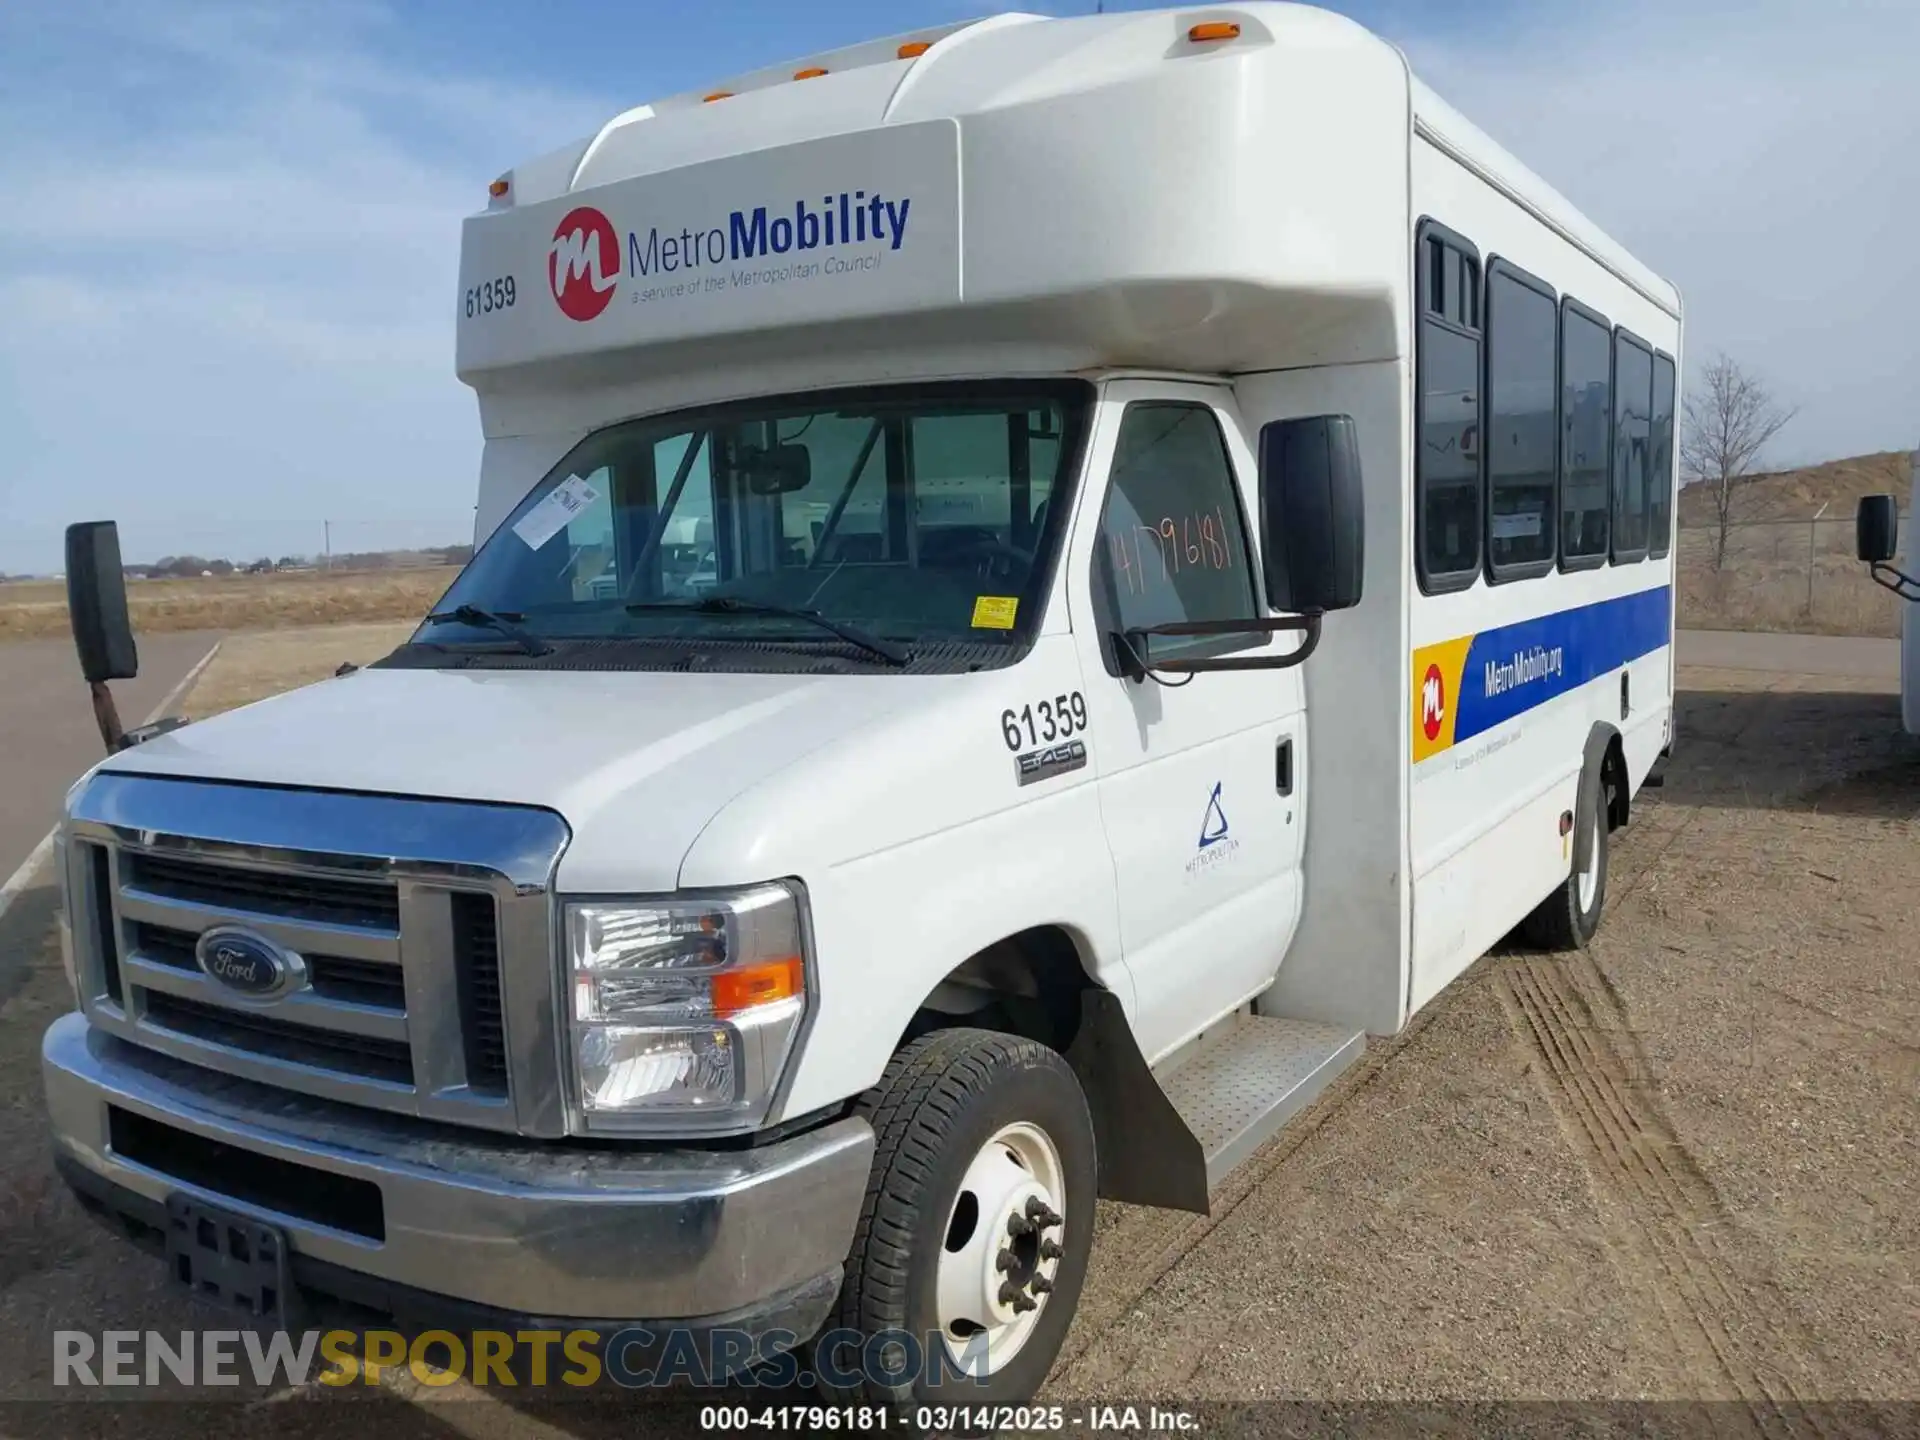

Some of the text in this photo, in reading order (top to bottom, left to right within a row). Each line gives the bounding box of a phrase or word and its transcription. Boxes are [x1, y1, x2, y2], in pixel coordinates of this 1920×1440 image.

[629, 191, 911, 278] MetroMobility
[466, 276, 516, 318] 61359
[631, 250, 883, 304] a service of the Metropolitan Council
[1111, 505, 1232, 596] 41796181
[1485, 645, 1562, 698] MetroMobility.org
[1002, 691, 1087, 752] 61359
[214, 947, 257, 983] Ford
